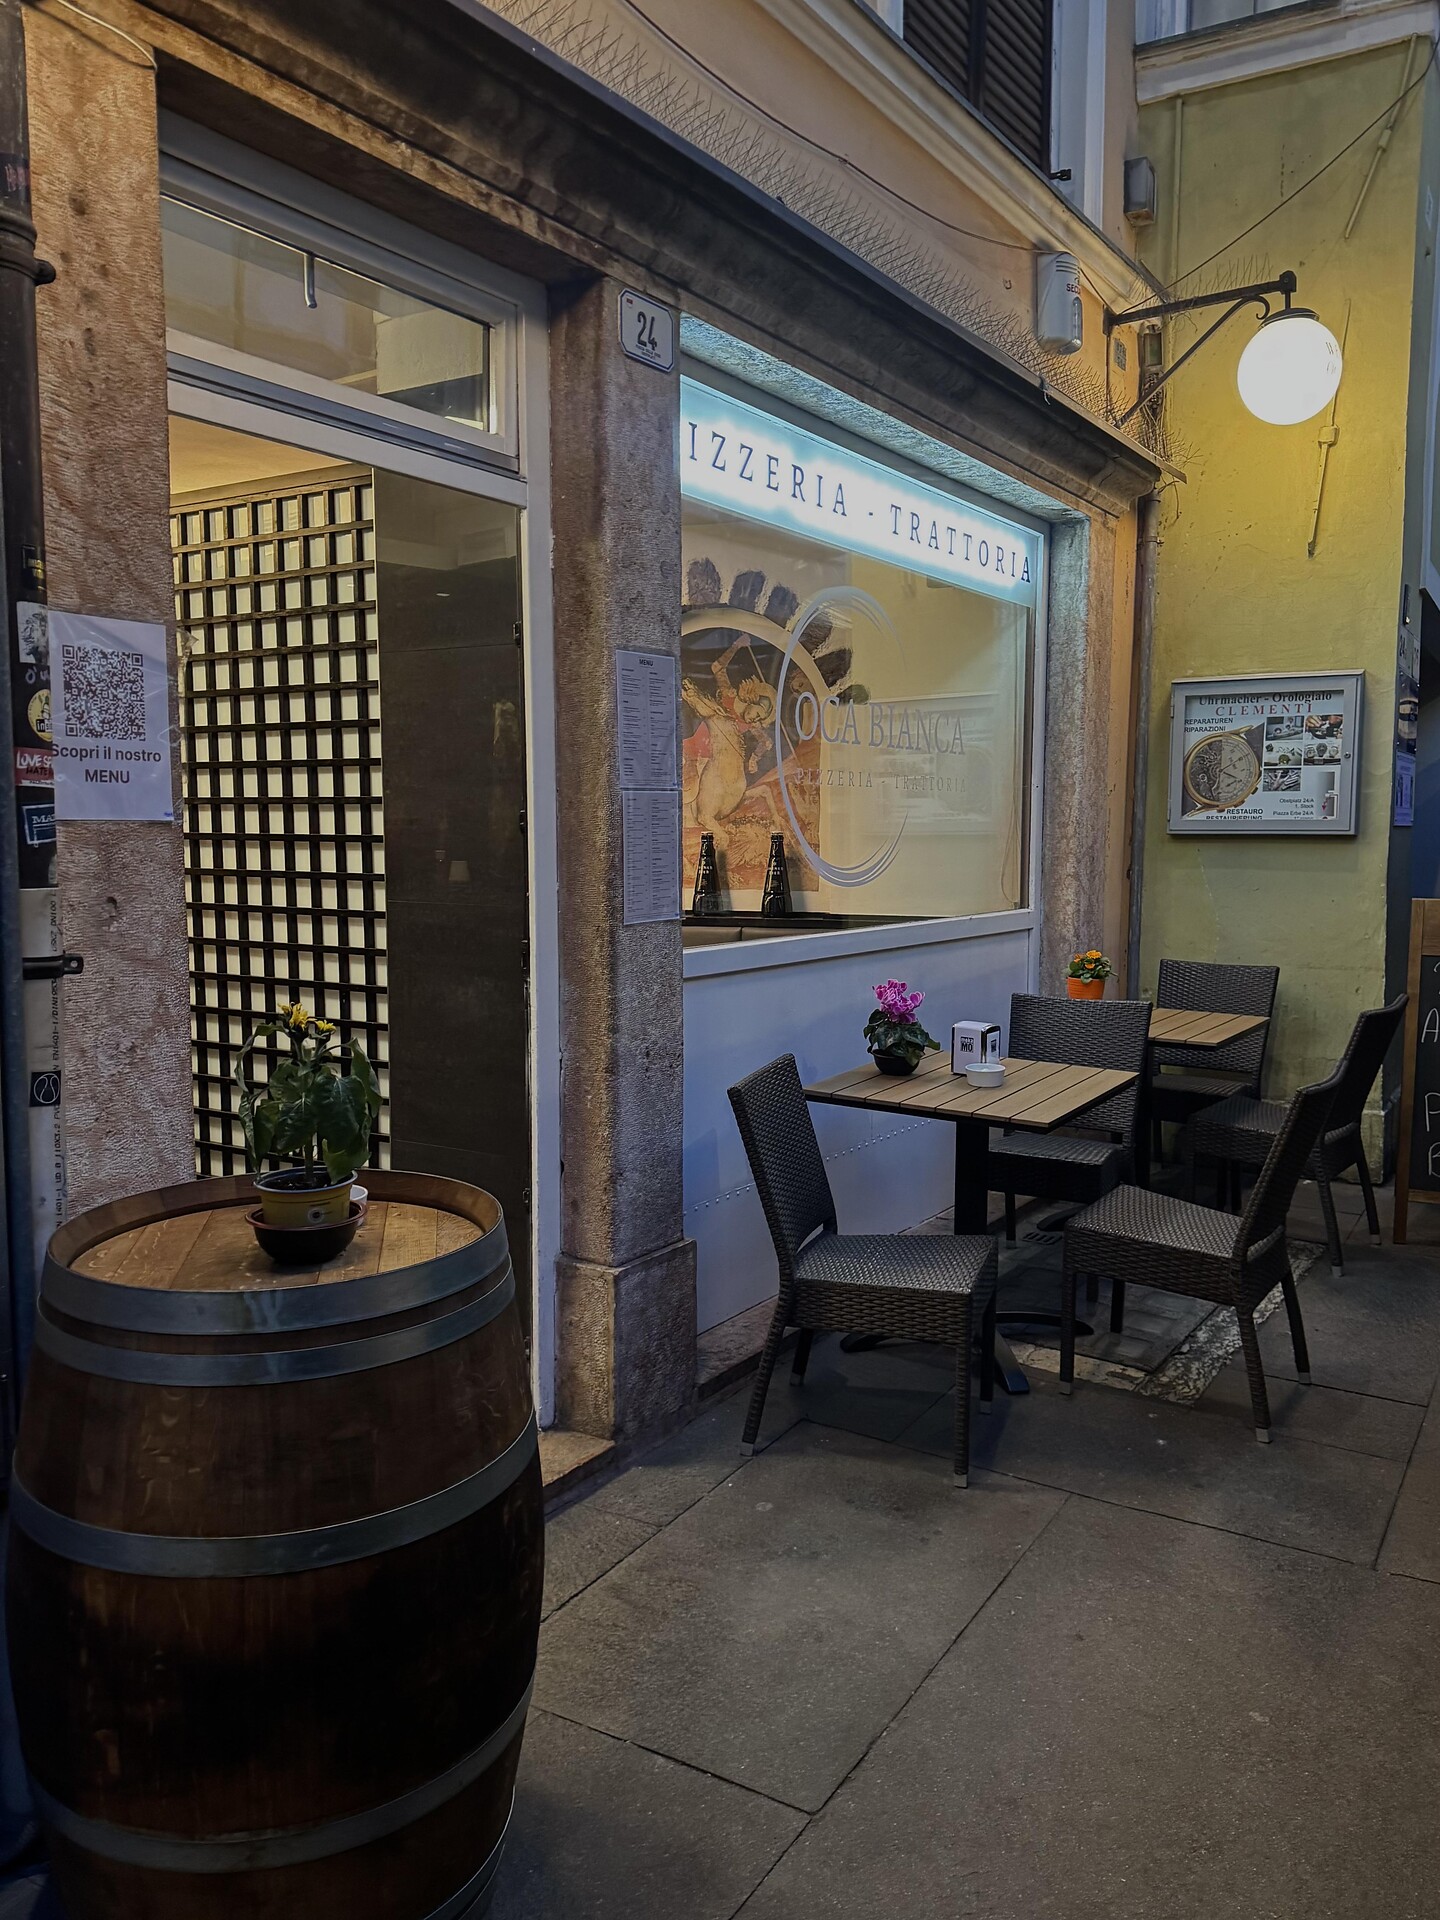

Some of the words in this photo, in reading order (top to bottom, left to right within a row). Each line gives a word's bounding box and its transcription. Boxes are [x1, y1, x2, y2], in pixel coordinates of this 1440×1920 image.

[637, 311, 658, 351] 24
[688, 421, 848, 517] IZZERIA
[890, 503, 1032, 584] TRATTORIA
[639, 659, 654, 667] MENU
[1199, 695, 1261, 706] Uhrmacher
[1272, 691, 1332, 704] Orologiaio
[1215, 703, 1313, 716] CLEMENTI
[795, 691, 861, 745] OCA
[869, 702, 966, 755] BIANCA
[1184, 717, 1234, 726] REPARATUREN
[1184, 725, 1226, 733] RIPARAZIONI
[17, 751, 41, 768] LOVE
[51, 744, 99, 761] Scopri
[103, 746, 111, 760] il
[115, 749, 161, 762] nostro
[85, 769, 130, 783] MENU
[796, 768, 873, 788] PIZZERIA
[894, 775, 966, 793] TRATTORIA
